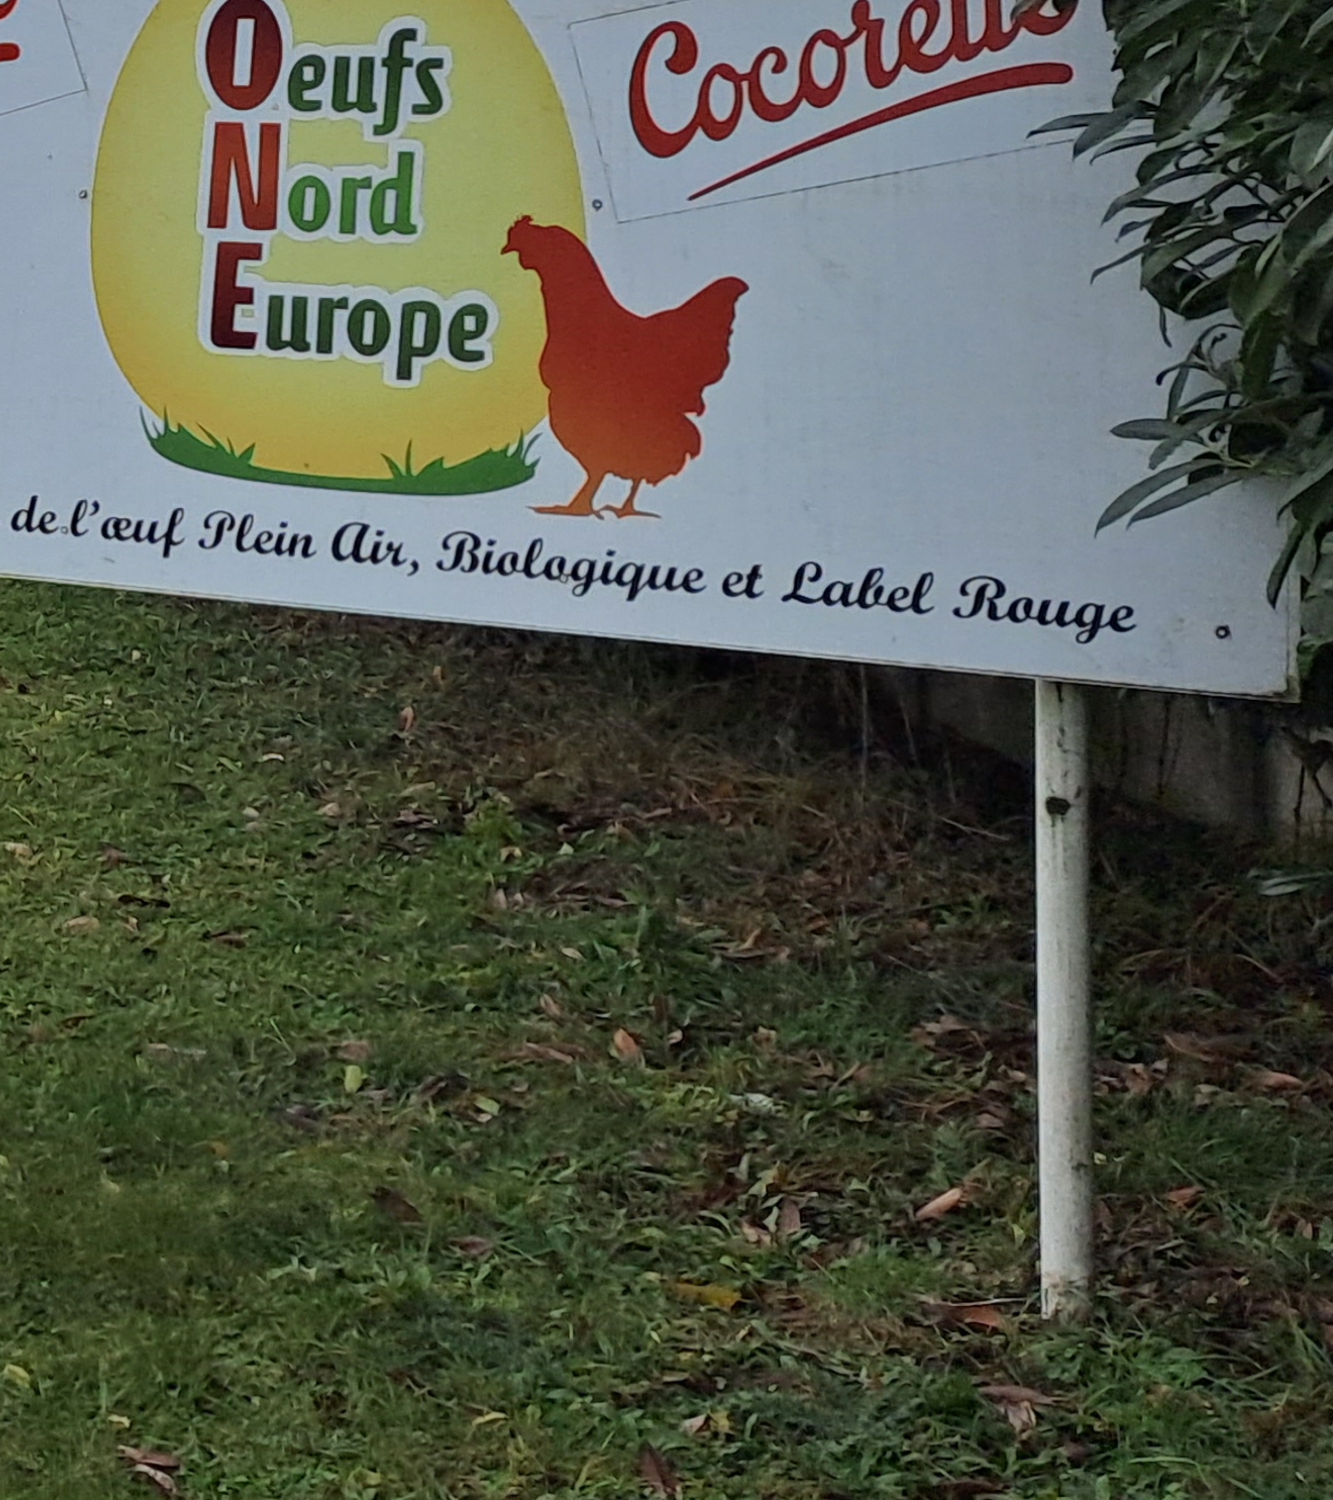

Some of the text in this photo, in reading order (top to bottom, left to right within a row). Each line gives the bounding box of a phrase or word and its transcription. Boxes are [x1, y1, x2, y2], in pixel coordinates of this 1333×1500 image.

[207, 121, 418, 236] Nord
[210, 241, 490, 382] Europe
[10, 495, 58, 535] de
[198, 509, 317, 559] Plein
[331, 521, 420, 577] Air,
[436, 529, 708, 602] Biologique
[721, 563, 765, 600] et
[781, 560, 936, 616] Label
[952, 574, 1137, 645] Rouge
